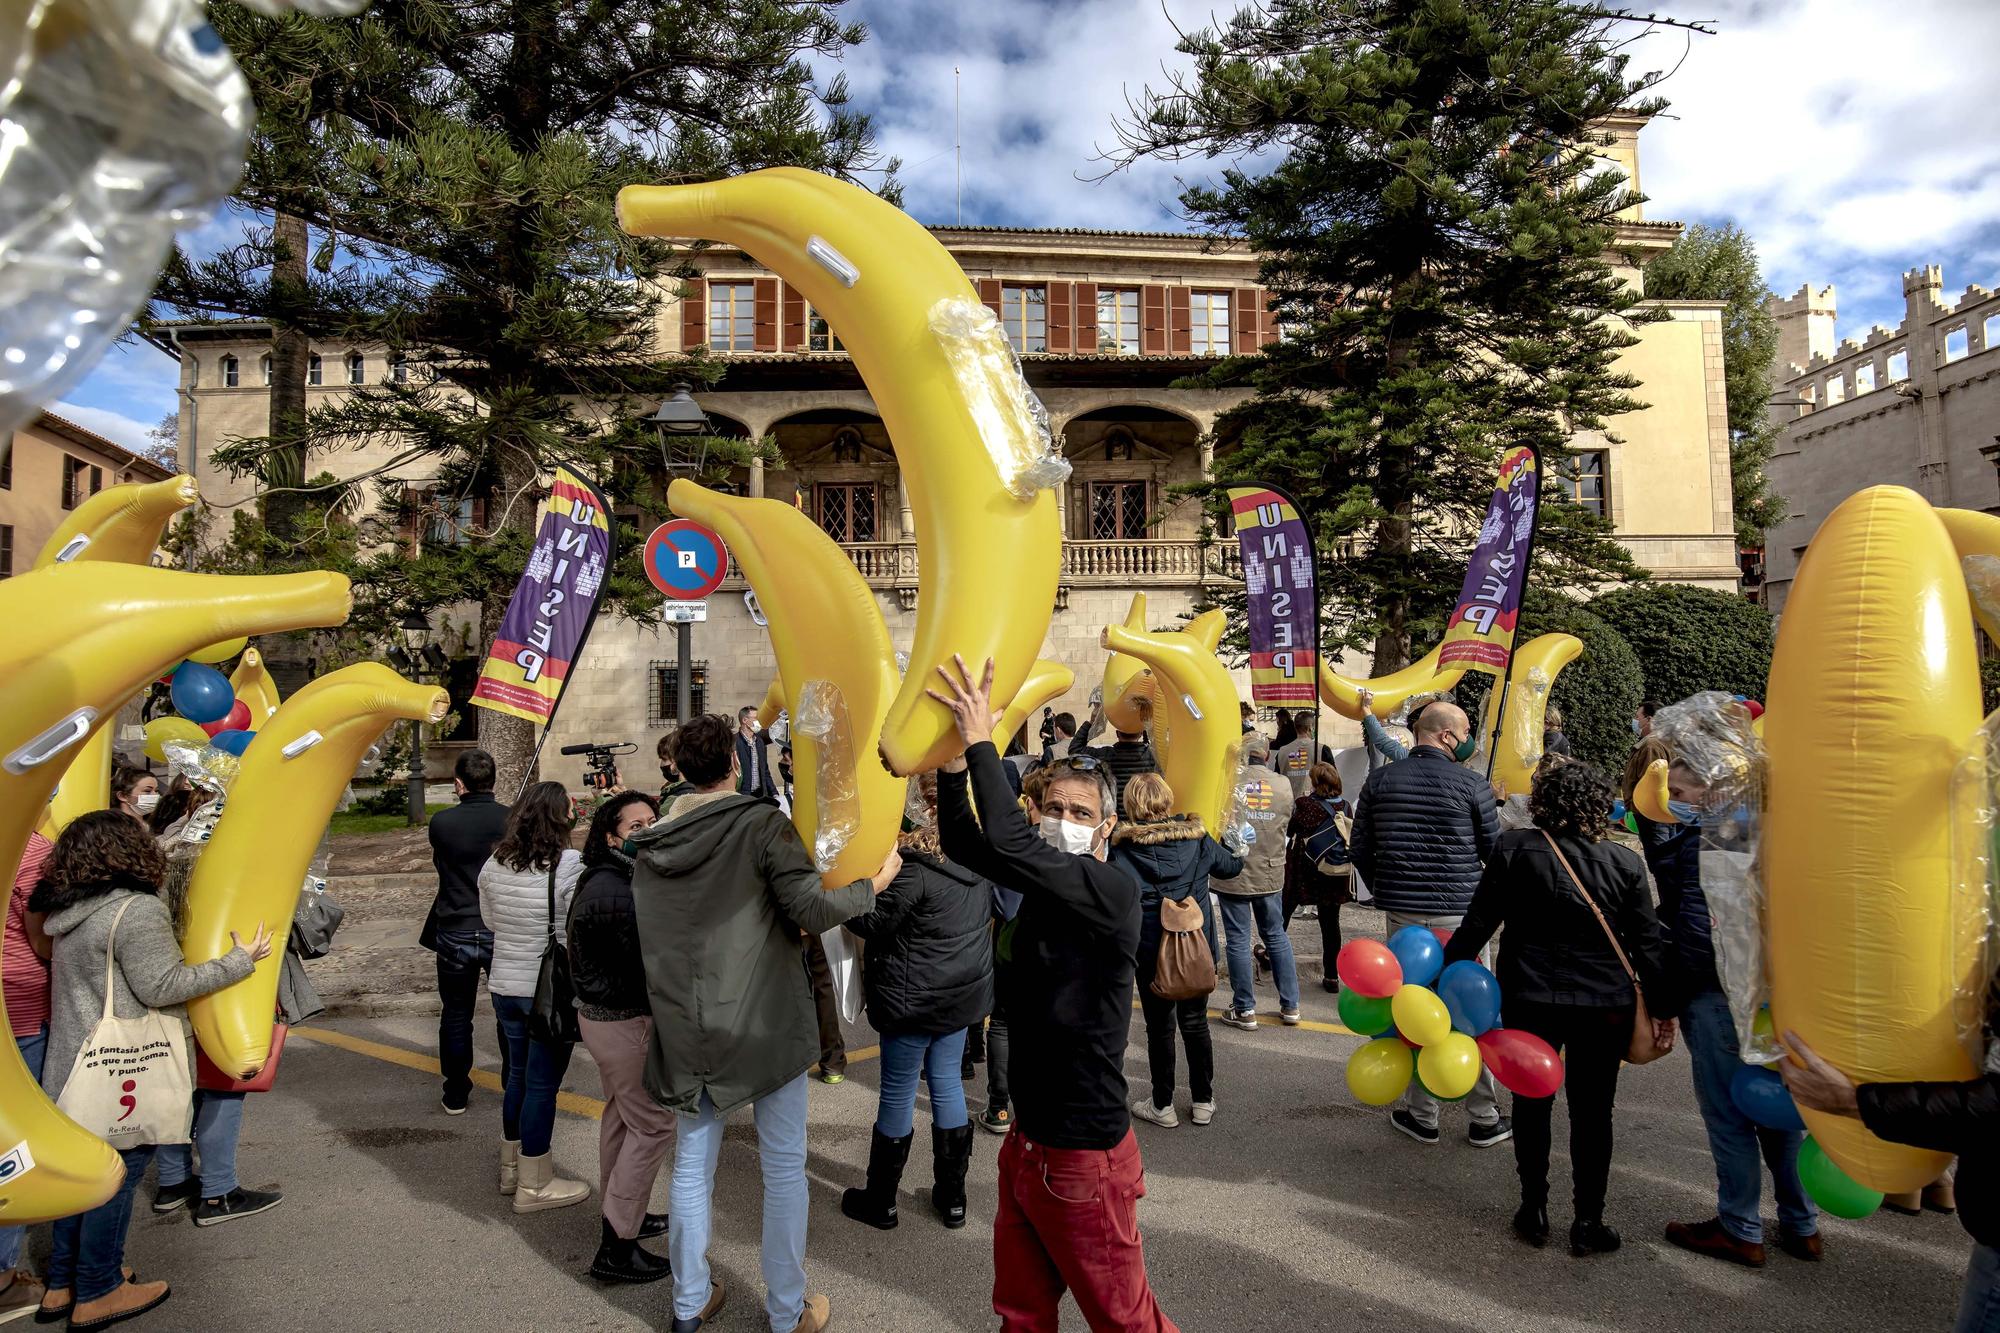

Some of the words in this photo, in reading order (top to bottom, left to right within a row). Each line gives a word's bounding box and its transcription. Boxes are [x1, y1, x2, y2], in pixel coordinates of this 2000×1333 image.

[684, 553, 690, 565] P
[84, 1049, 97, 1059] Mi
[99, 1046, 140, 1055] fantasia
[142, 1040, 171, 1051] textua
[101, 1057, 120, 1066] que
[139, 1051, 169, 1062] comas
[118, 1066, 149, 1076] punto.
[108, 1124, 141, 1134] Re-Read
